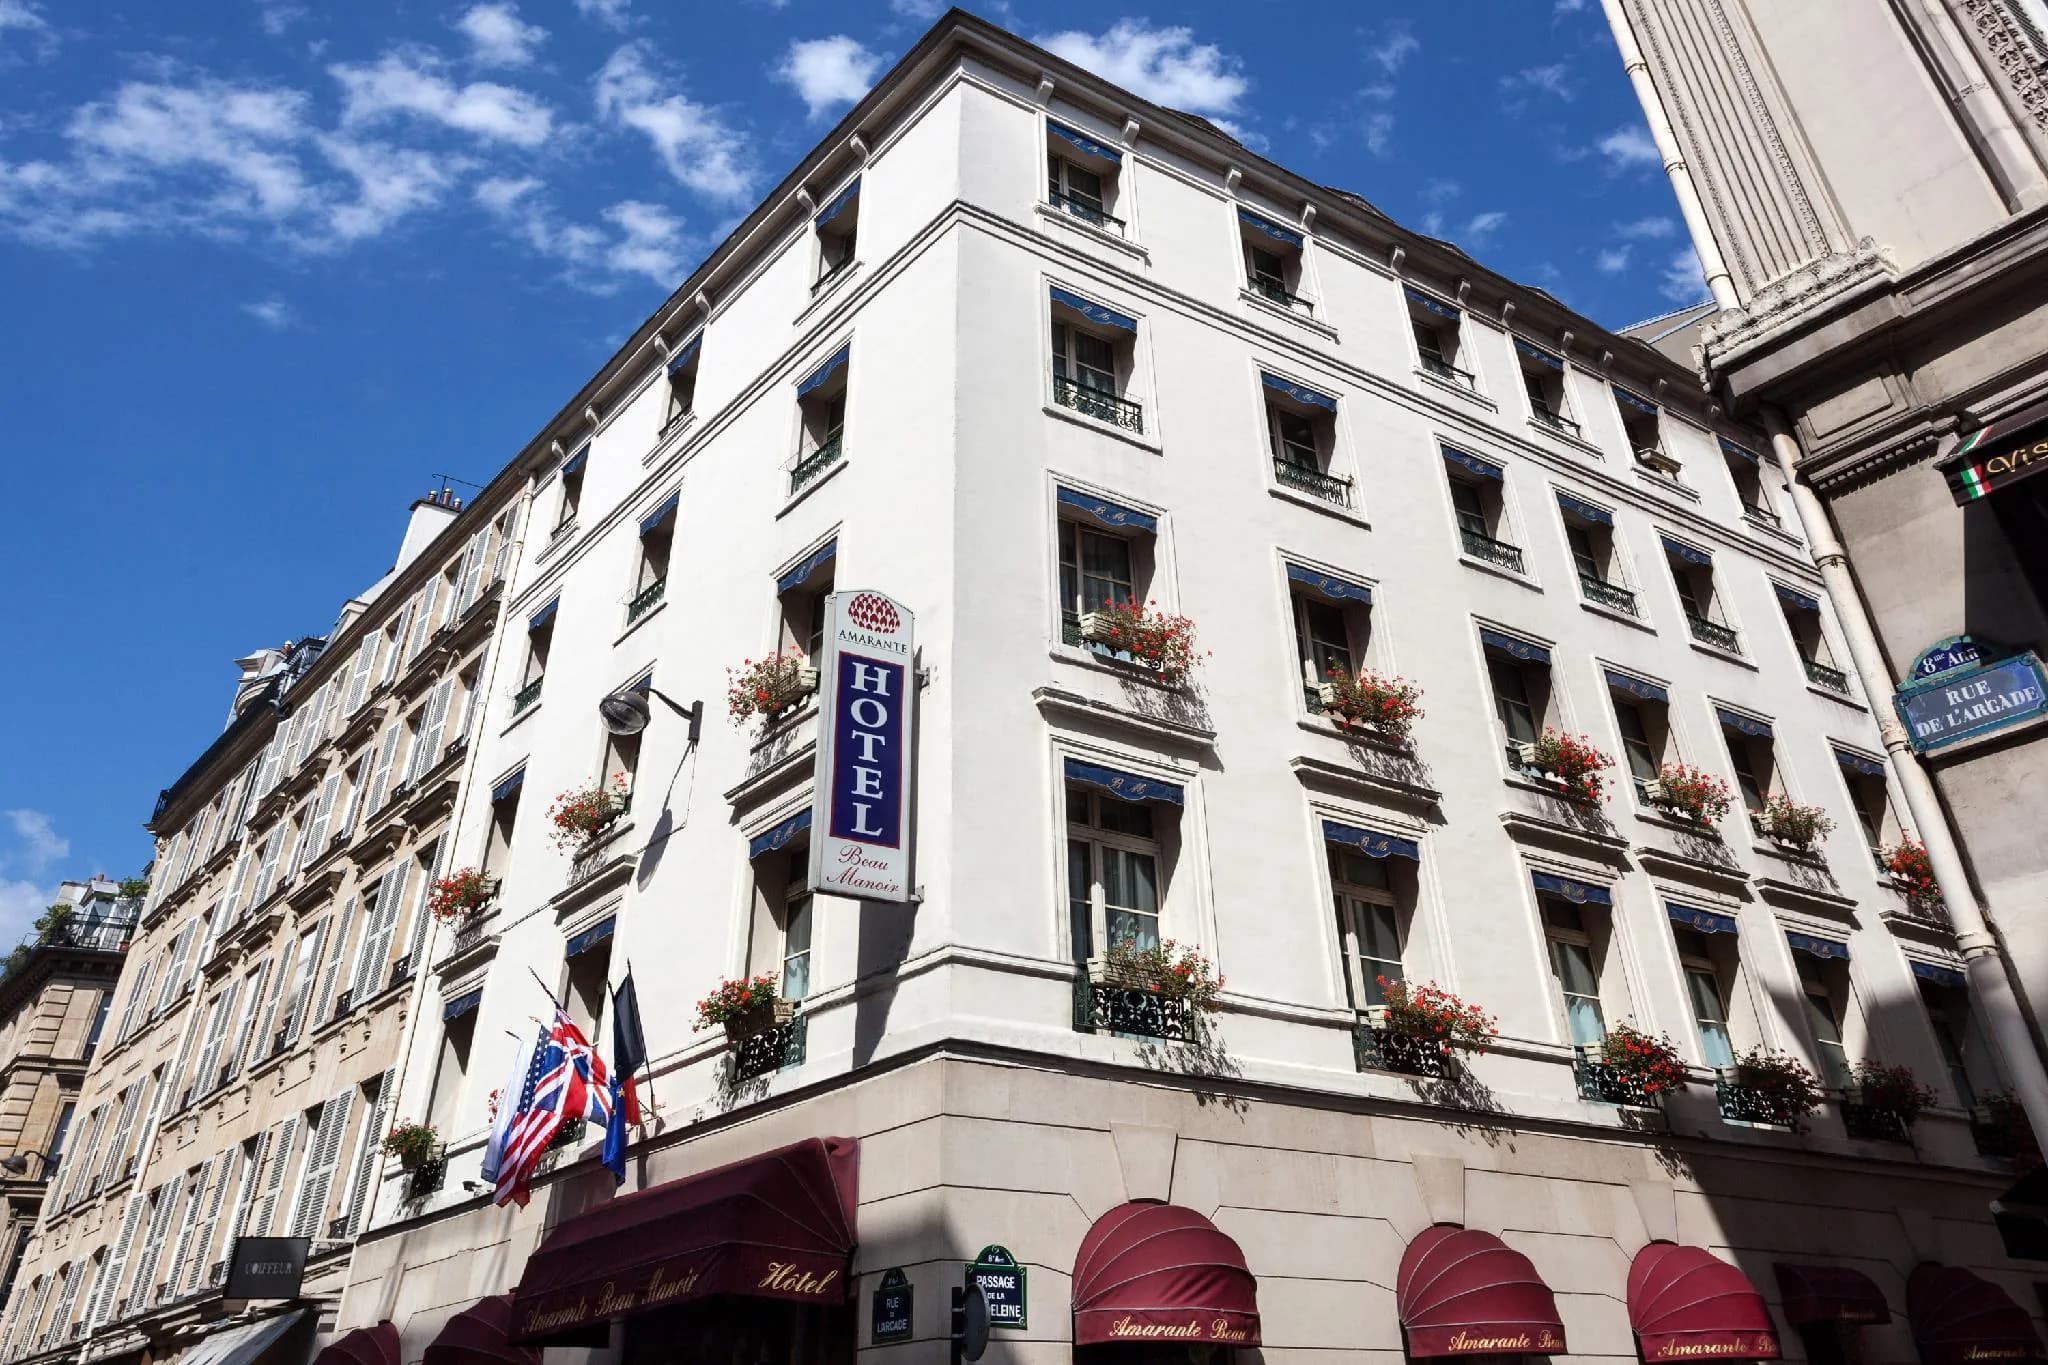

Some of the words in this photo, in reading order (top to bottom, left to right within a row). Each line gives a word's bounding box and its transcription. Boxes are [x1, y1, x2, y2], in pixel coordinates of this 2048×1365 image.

[838, 629, 908, 654] AMARANTE
[1945, 680, 1992, 706] RUE
[1915, 717, 1945, 738] DE
[1946, 686, 2040, 727] L'ARCADE
[850, 662, 891, 838] HOTEL
[838, 844, 888, 870] Beau
[826, 866, 900, 893] Manoir
[758, 1262, 839, 1294] Hôtel
[976, 1275, 1015, 1289] PASSAGE
[595, 1281, 636, 1318] Beau
[886, 1297, 899, 1310] RUE
[996, 1292, 1005, 1300] LA
[990, 1304, 1022, 1318] ELEINE
[1109, 1315, 1202, 1337] Amarante
[1210, 1318, 1247, 1341] Beau
[1448, 1331, 1531, 1352] Amarante
[1658, 1337, 1748, 1357] Amarante
